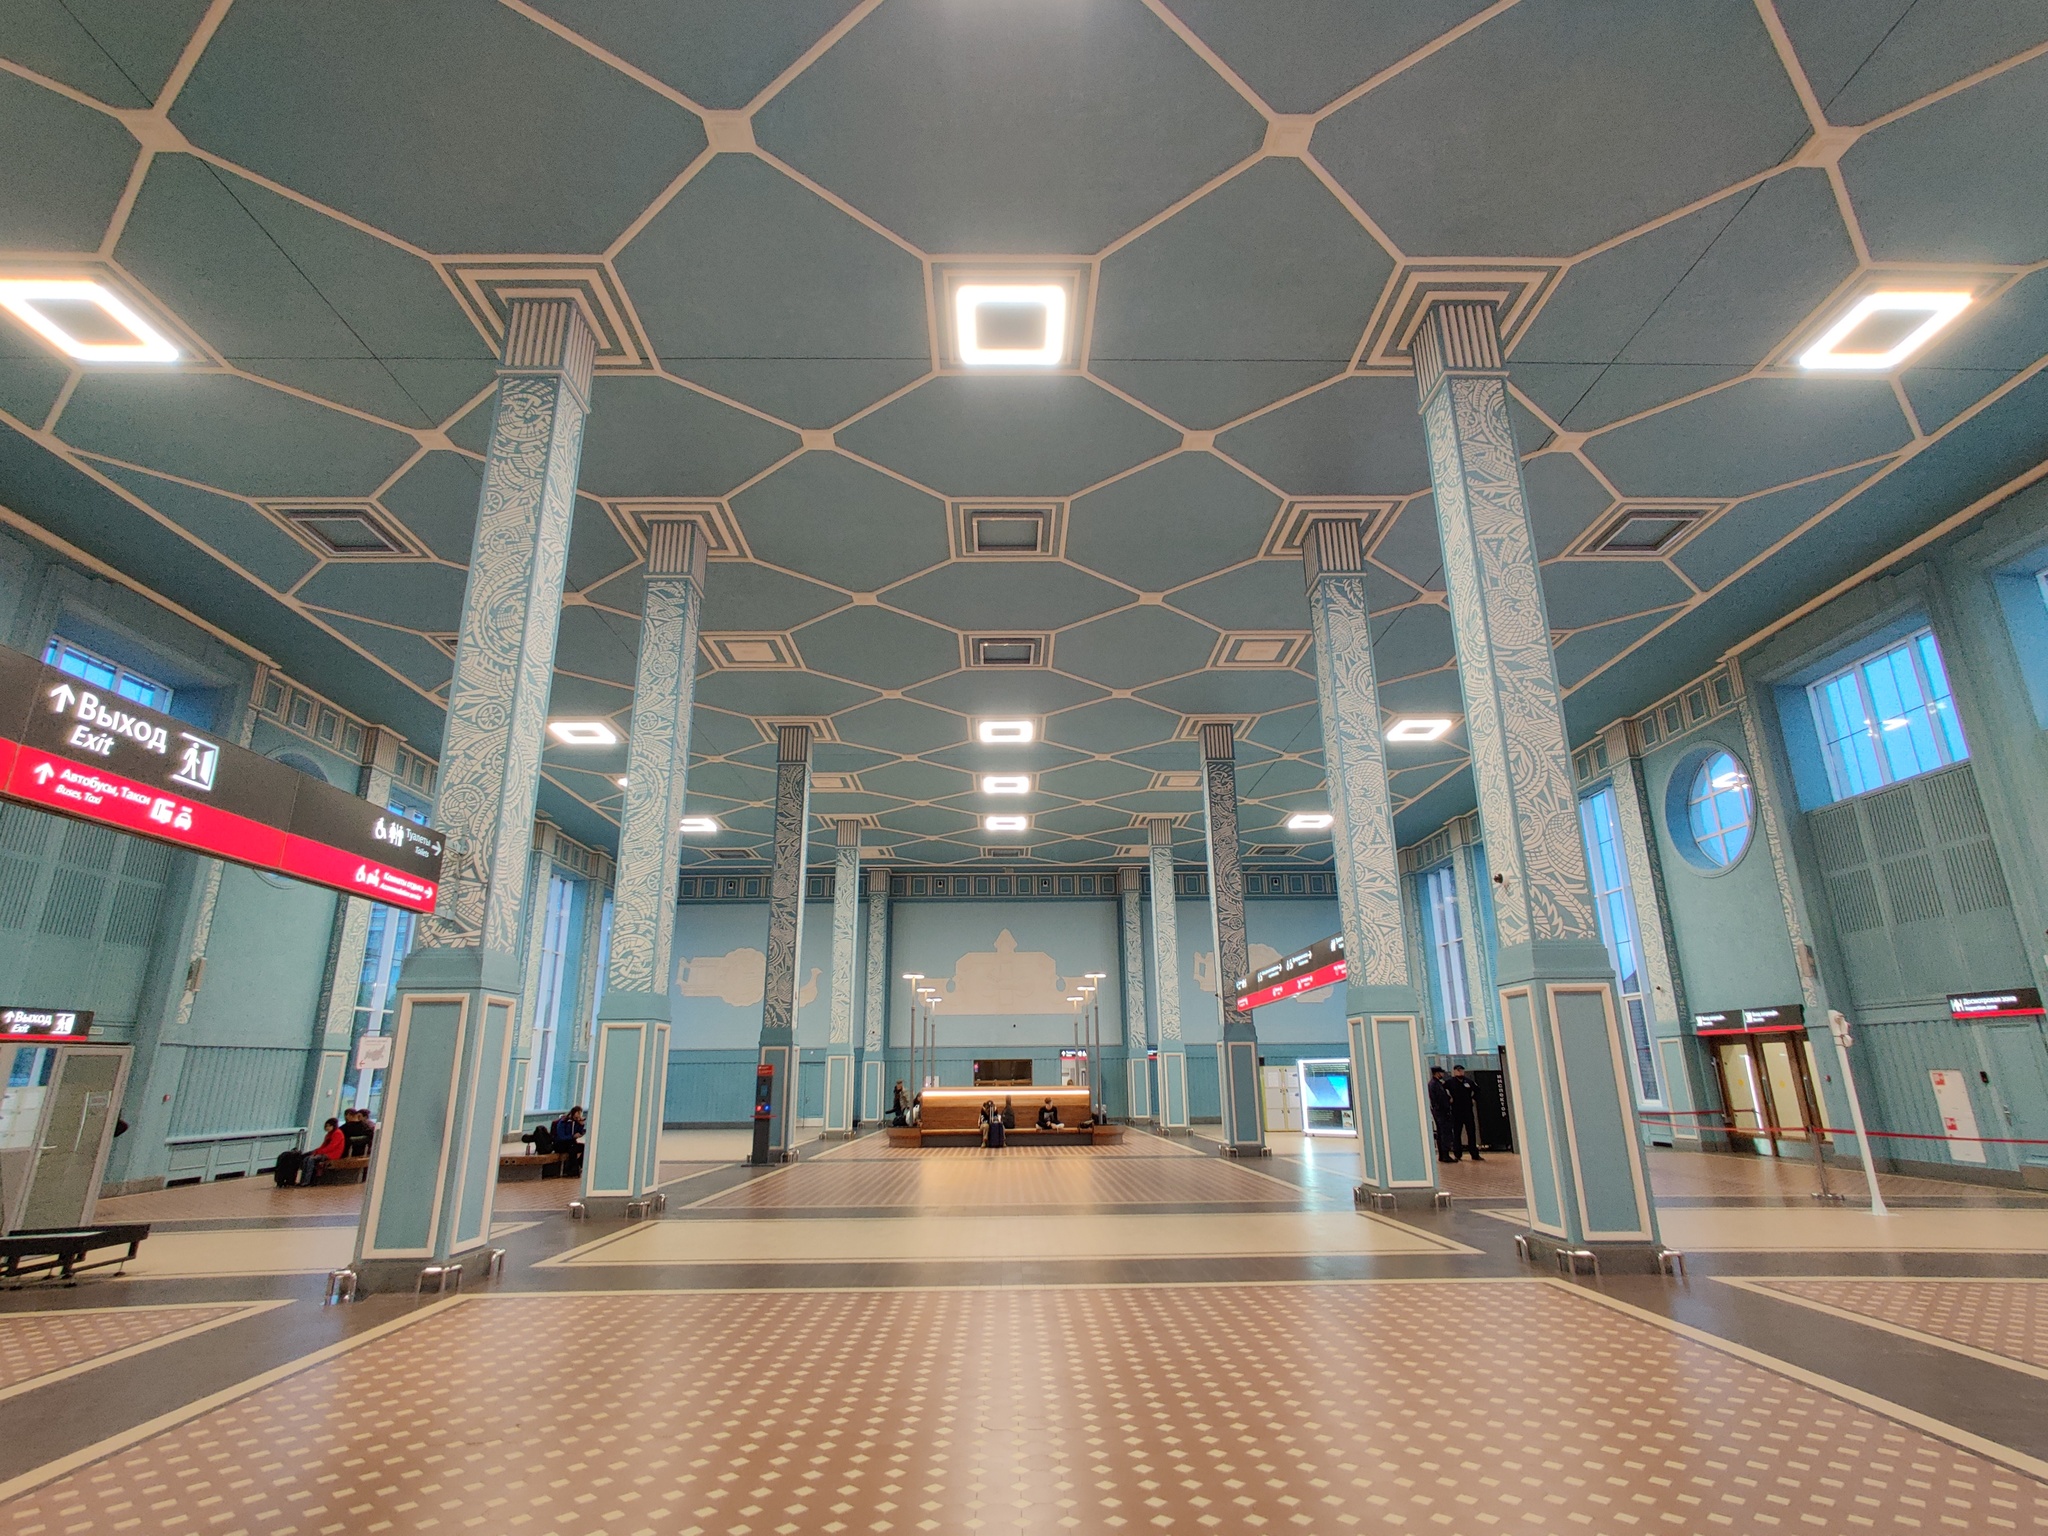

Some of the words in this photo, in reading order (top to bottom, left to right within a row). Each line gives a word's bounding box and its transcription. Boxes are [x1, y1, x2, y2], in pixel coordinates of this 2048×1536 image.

[77, 691, 169, 754] Выход
[69, 725, 115, 756] Exit
[55, 784, 83, 800] Buses,
[84, 792, 103, 805] Taxi
[60, 769, 119, 797] Автобусы,
[121, 786, 151, 805] Такси
[406, 828, 431, 846] Туалеты
[415, 846, 429, 858] Toilets
[14, 1011, 52, 1026] Выход
[11, 1024, 30, 1033] Exit
